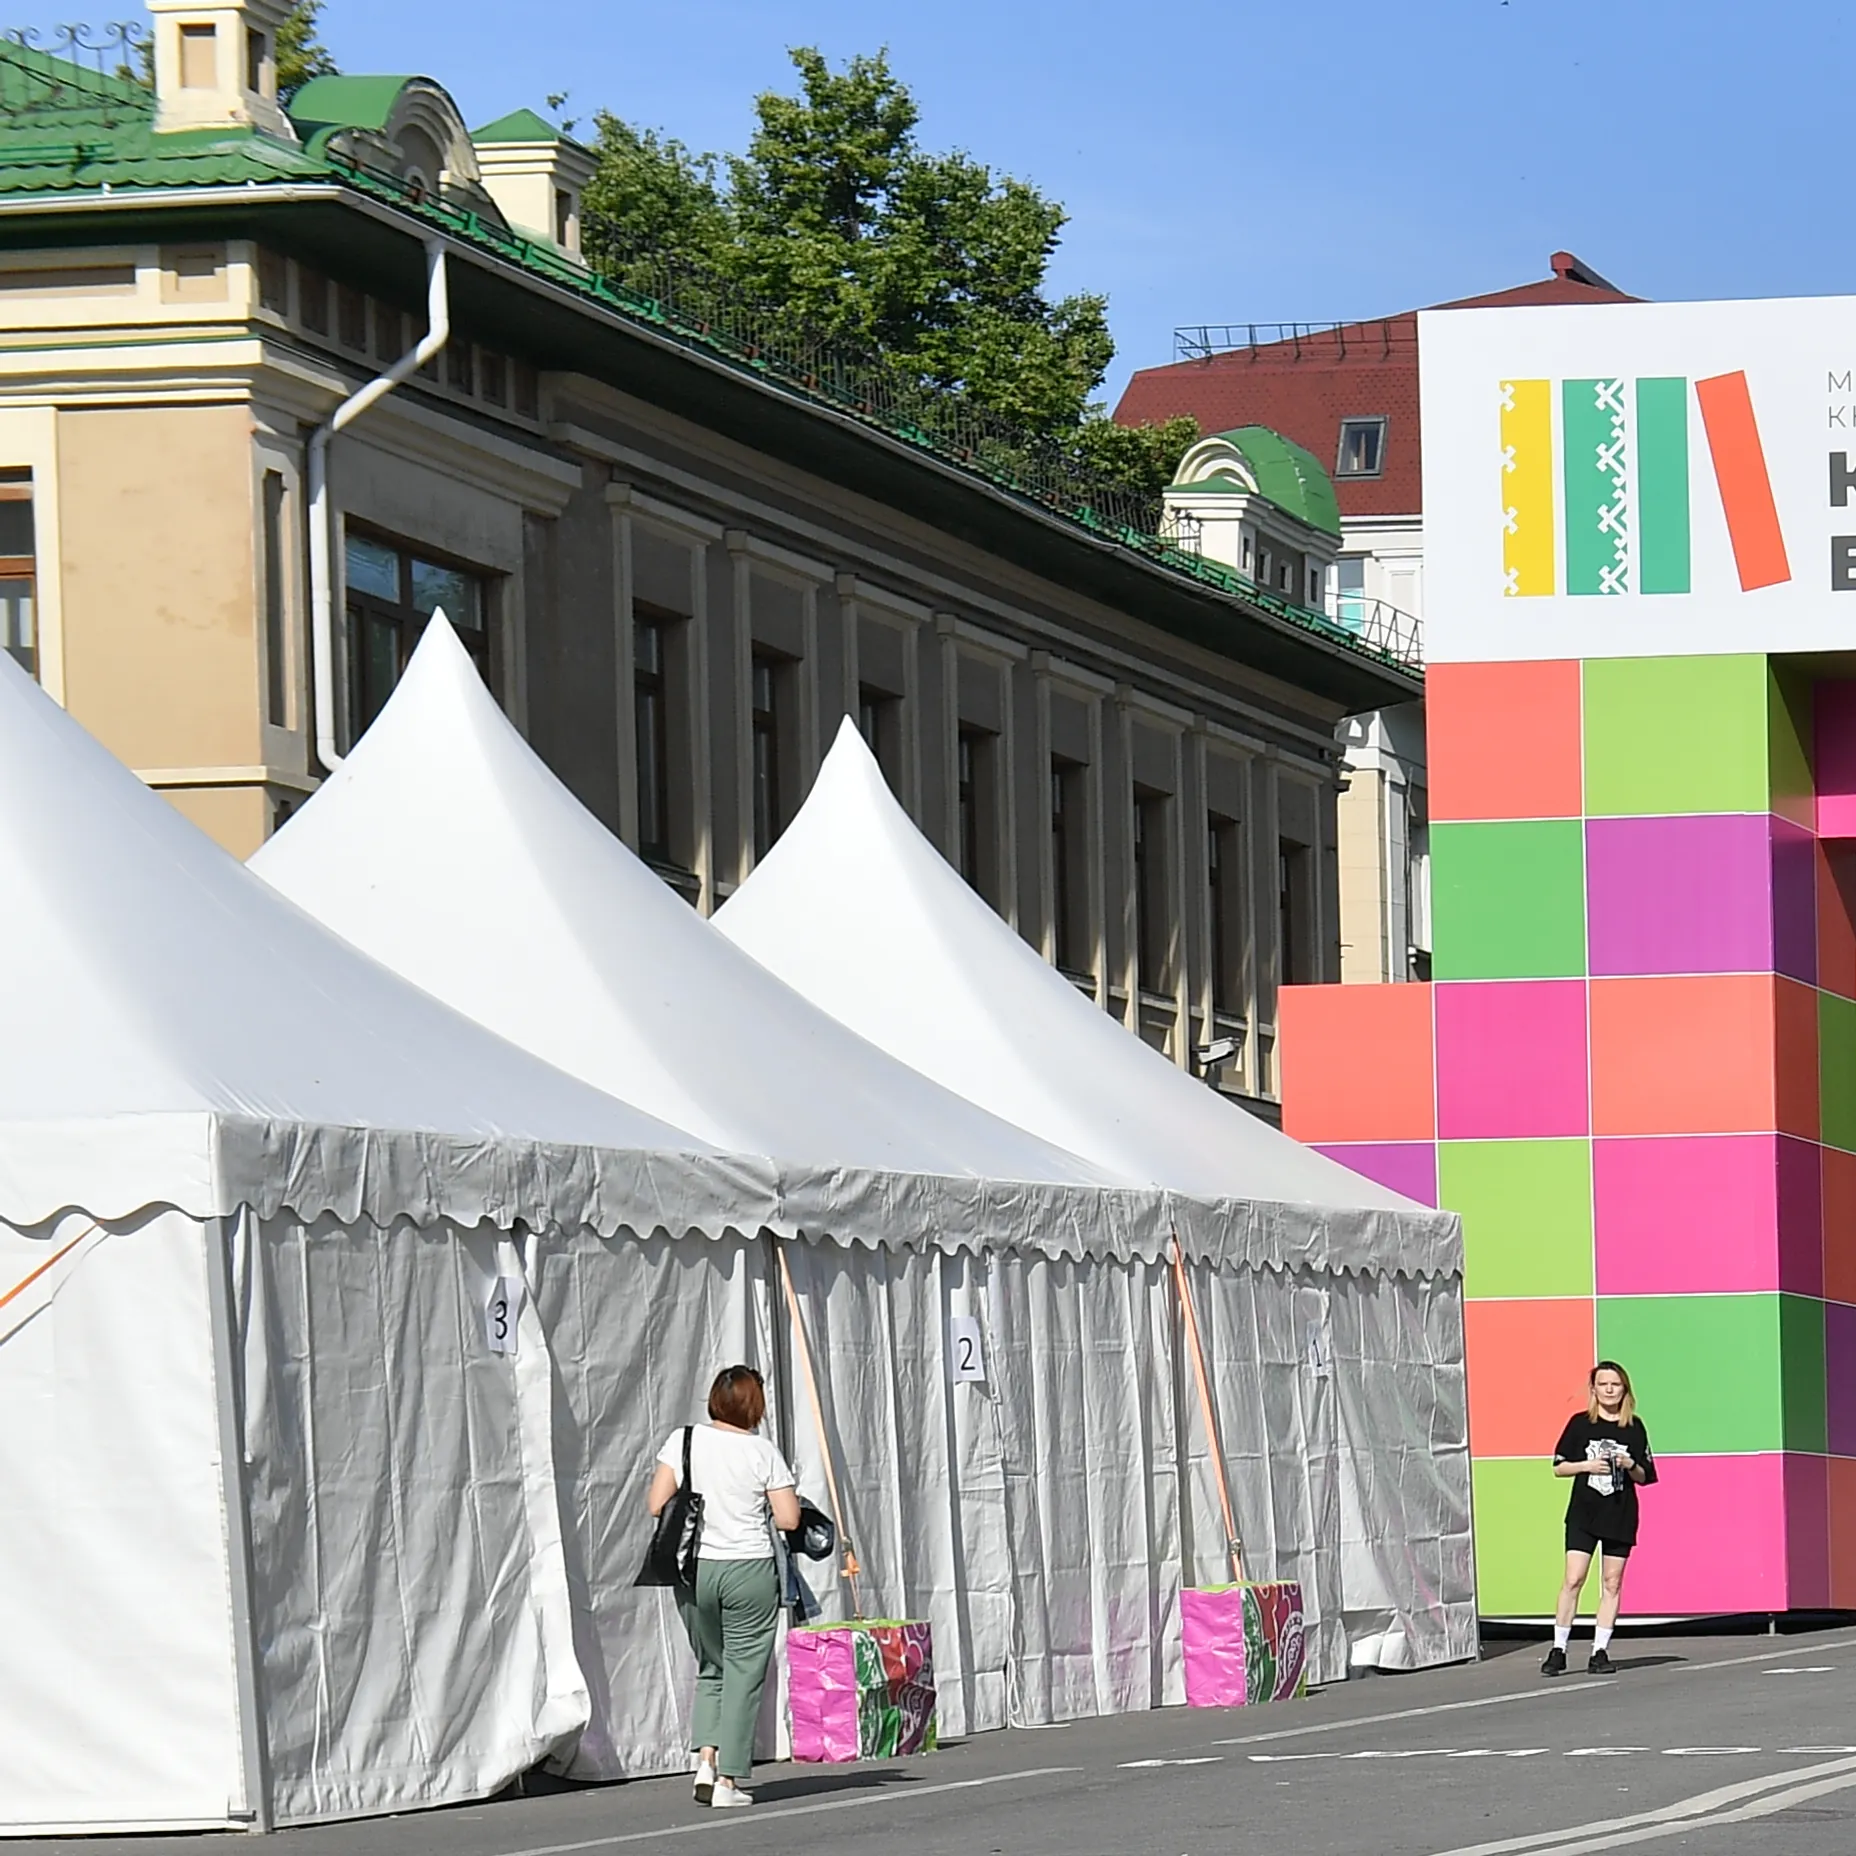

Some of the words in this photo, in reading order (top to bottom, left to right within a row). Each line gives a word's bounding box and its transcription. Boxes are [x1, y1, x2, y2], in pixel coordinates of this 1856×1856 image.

[495, 1300, 508, 1340] 3
[958, 1337, 976, 1371] 2
[1312, 1338, 1322, 1367] 1
